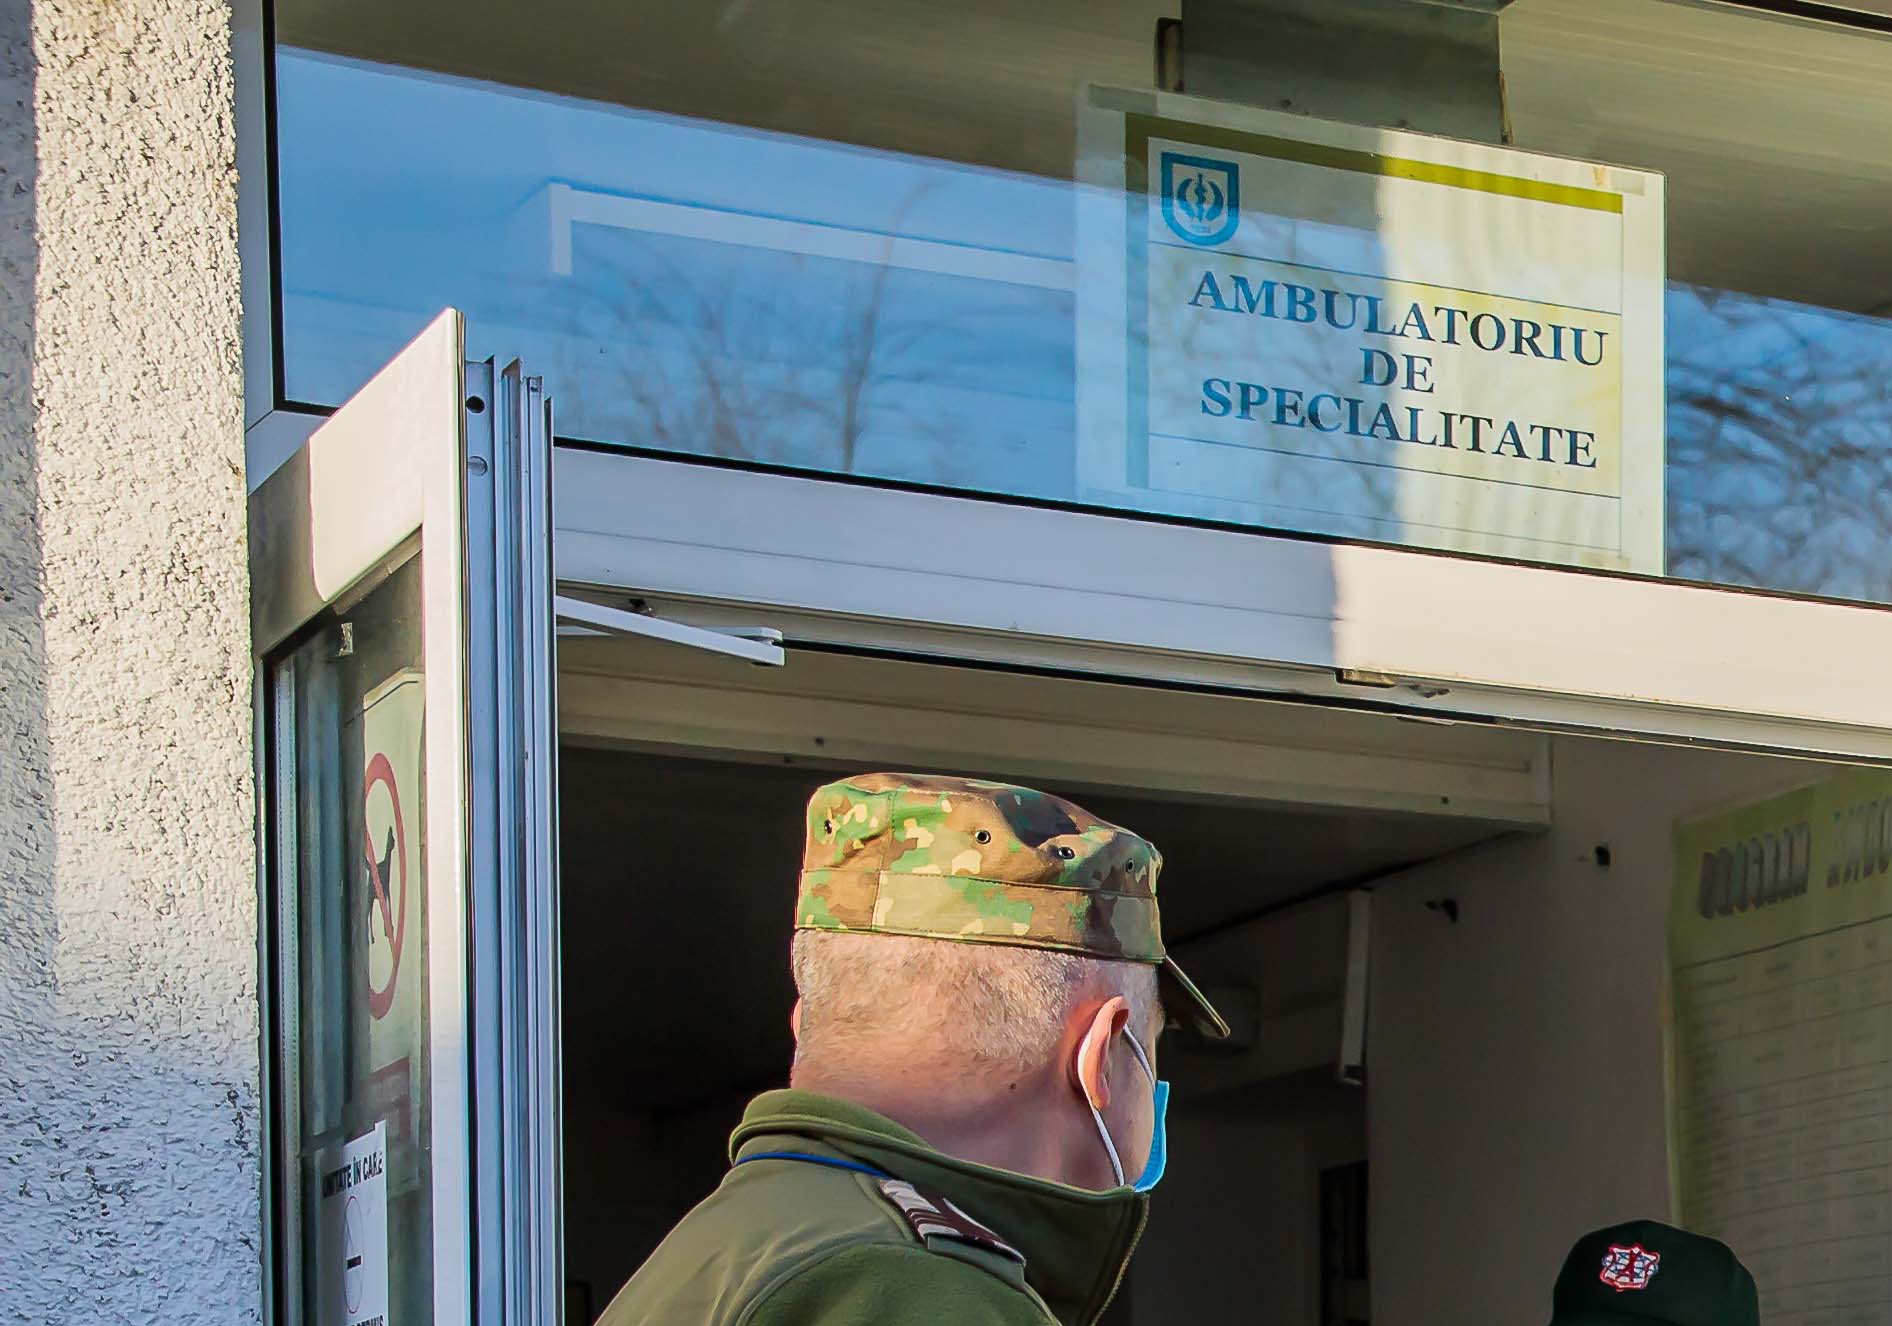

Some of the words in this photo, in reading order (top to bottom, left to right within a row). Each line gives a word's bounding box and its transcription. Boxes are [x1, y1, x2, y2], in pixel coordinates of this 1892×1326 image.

[1188, 270, 1609, 367] AMBULATORIU
[1359, 347, 1435, 394] DE
[1199, 377, 1597, 469] SPECIALITATE
